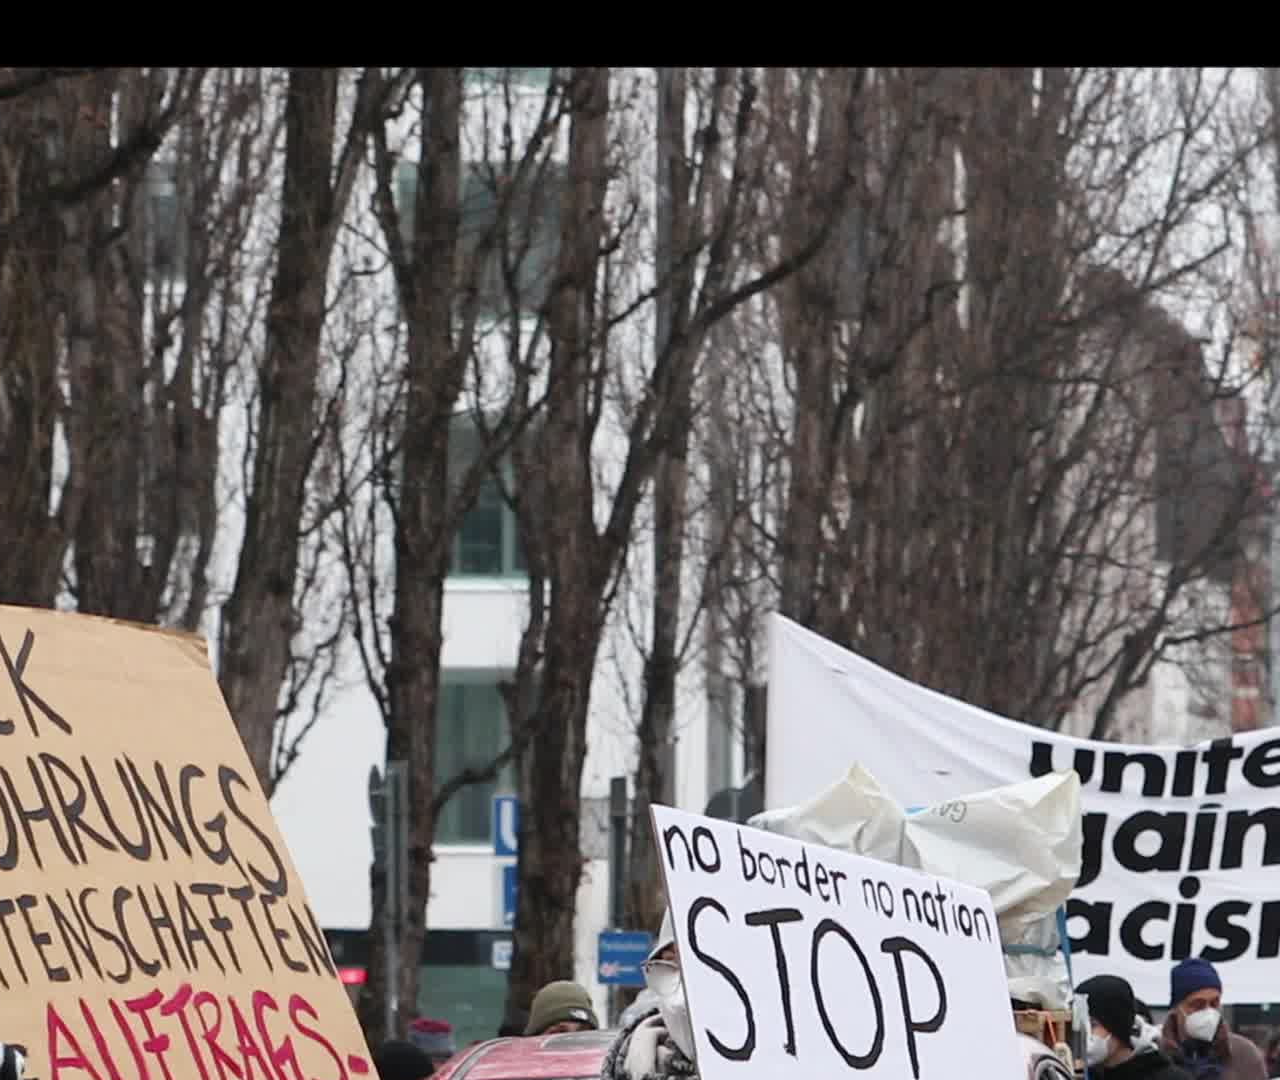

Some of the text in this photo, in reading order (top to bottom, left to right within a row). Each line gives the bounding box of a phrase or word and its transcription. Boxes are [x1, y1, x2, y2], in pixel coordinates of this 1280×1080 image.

[662, 824, 992, 942] no border no nation
[687, 896, 948, 1080] STOP
